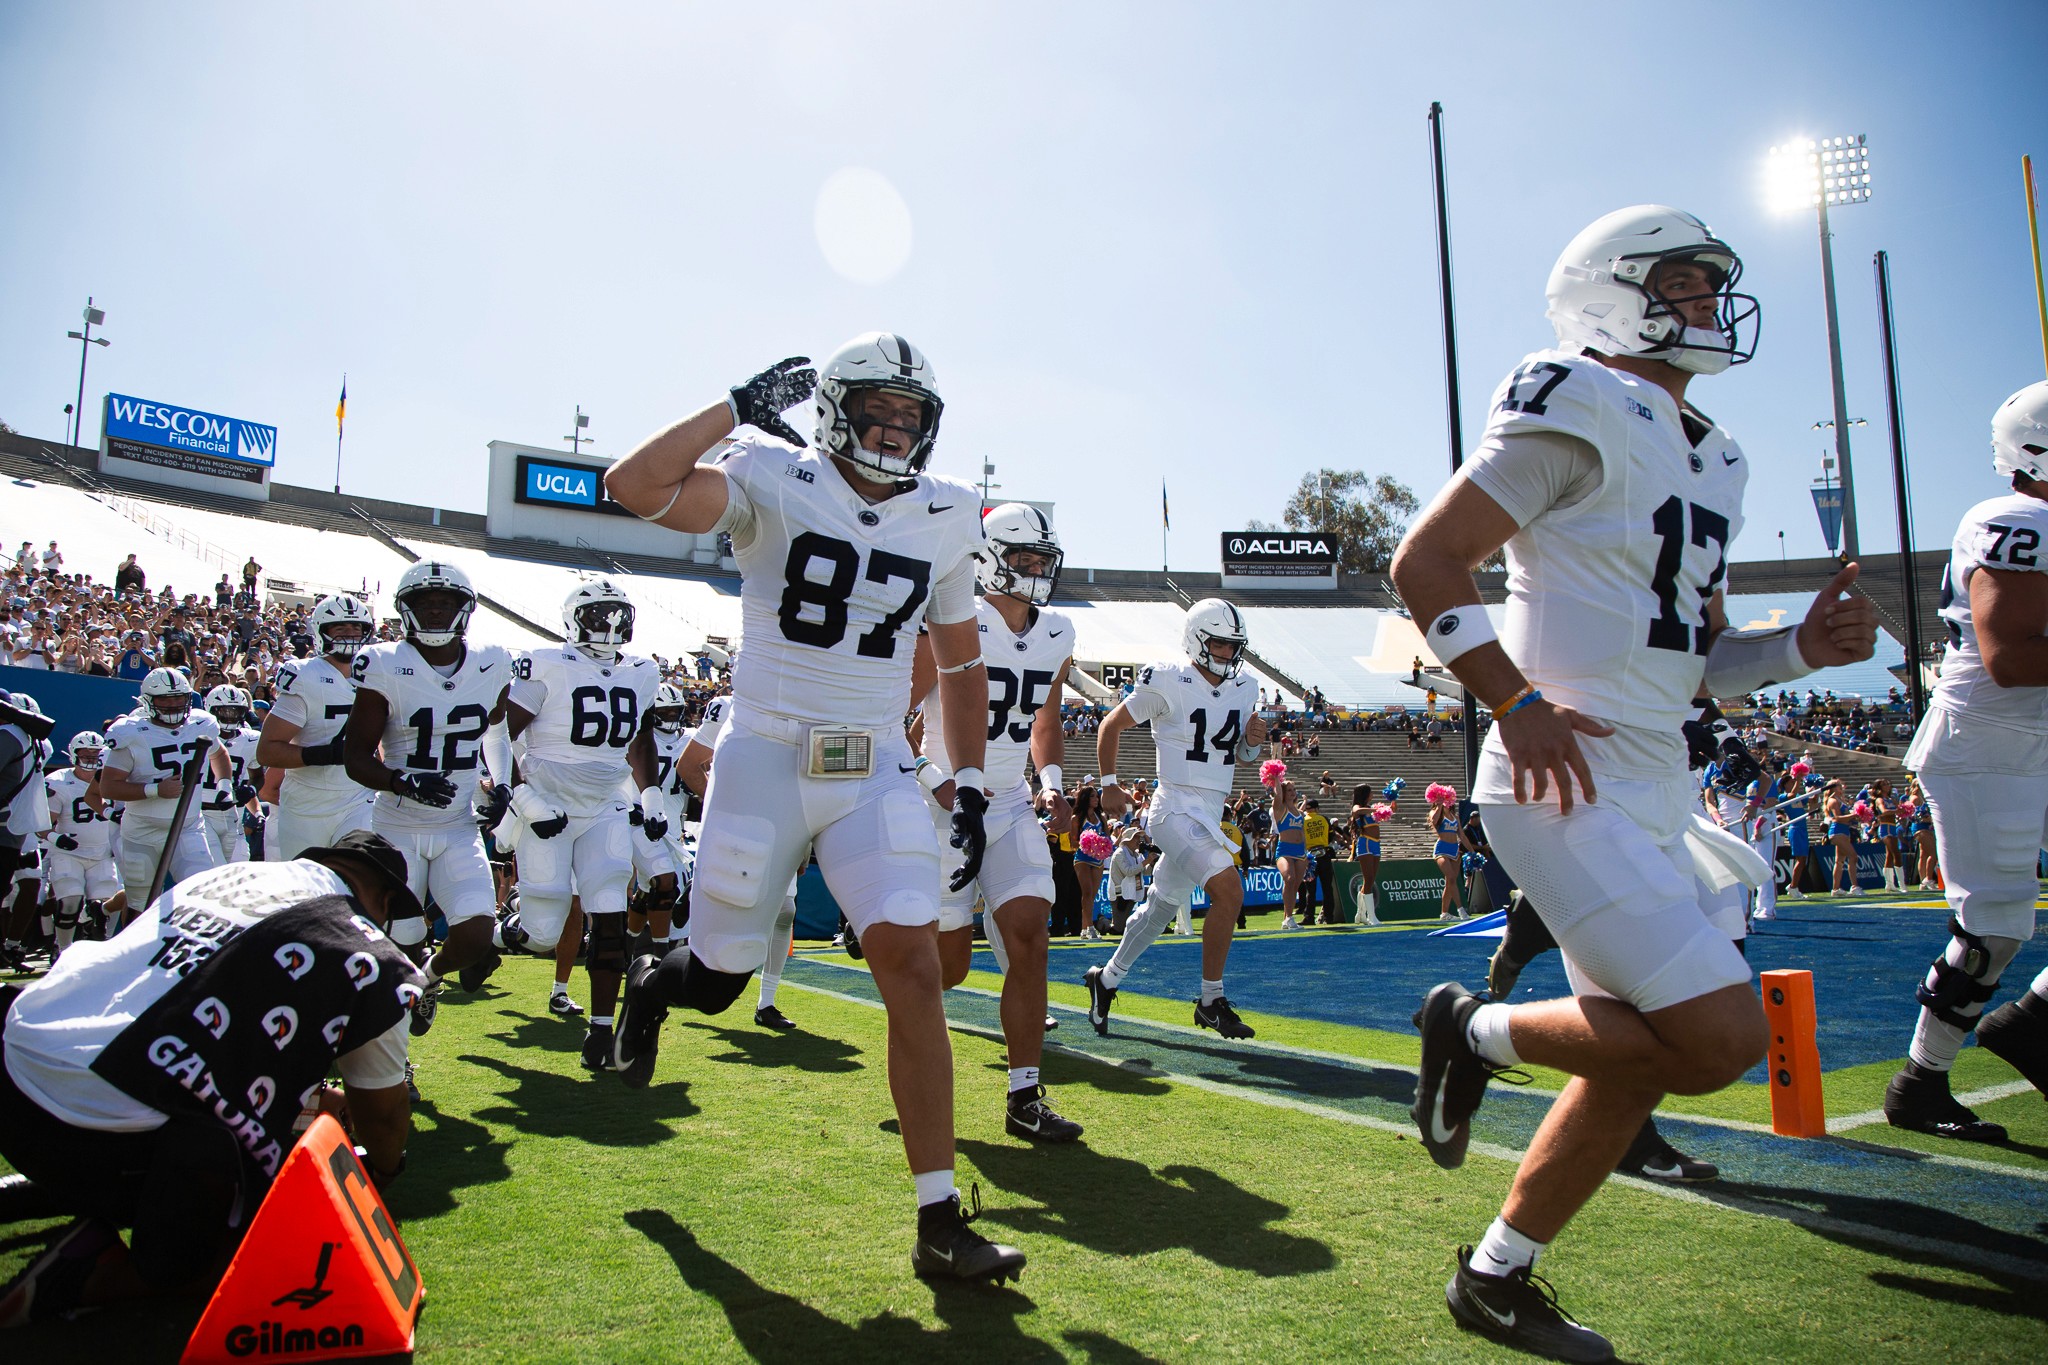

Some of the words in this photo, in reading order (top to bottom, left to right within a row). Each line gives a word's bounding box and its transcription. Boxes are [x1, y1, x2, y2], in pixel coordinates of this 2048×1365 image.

[1501, 361, 1572, 416] 17
[112, 397, 231, 442] WESCOM
[113, 441, 143, 452] REPORT
[144, 448, 183, 461] INCIDENTS
[184, 455, 195, 463] OF
[196, 457, 211, 467] FAN
[212, 461, 258, 474] MISCONDUCT
[169, 431, 230, 454] Financial
[123, 450, 142, 460] TEXT
[197, 465, 217, 474] WITH
[217, 469, 247, 479] DETAILS
[536, 472, 588, 497] UCLA
[1246, 539, 1331, 555] ACURA
[1986, 524, 2041, 567] 72
[1647, 494, 1729, 657] 17
[777, 531, 932, 659] 87
[351, 654, 371, 683] 2
[570, 685, 638, 747] 68
[406, 703, 490, 770] 12
[1185, 707, 1241, 765] 14
[1307, 820, 1323, 828] CSC
[1245, 871, 1285, 891] WESCO
[1381, 880, 1402, 891] OLD
[1403, 877, 1447, 889] DOMINIO
[1388, 890, 1430, 901] FREIGHT
[147, 1034, 284, 1183] GATORA
[224, 1320, 365, 1357] Gilman
